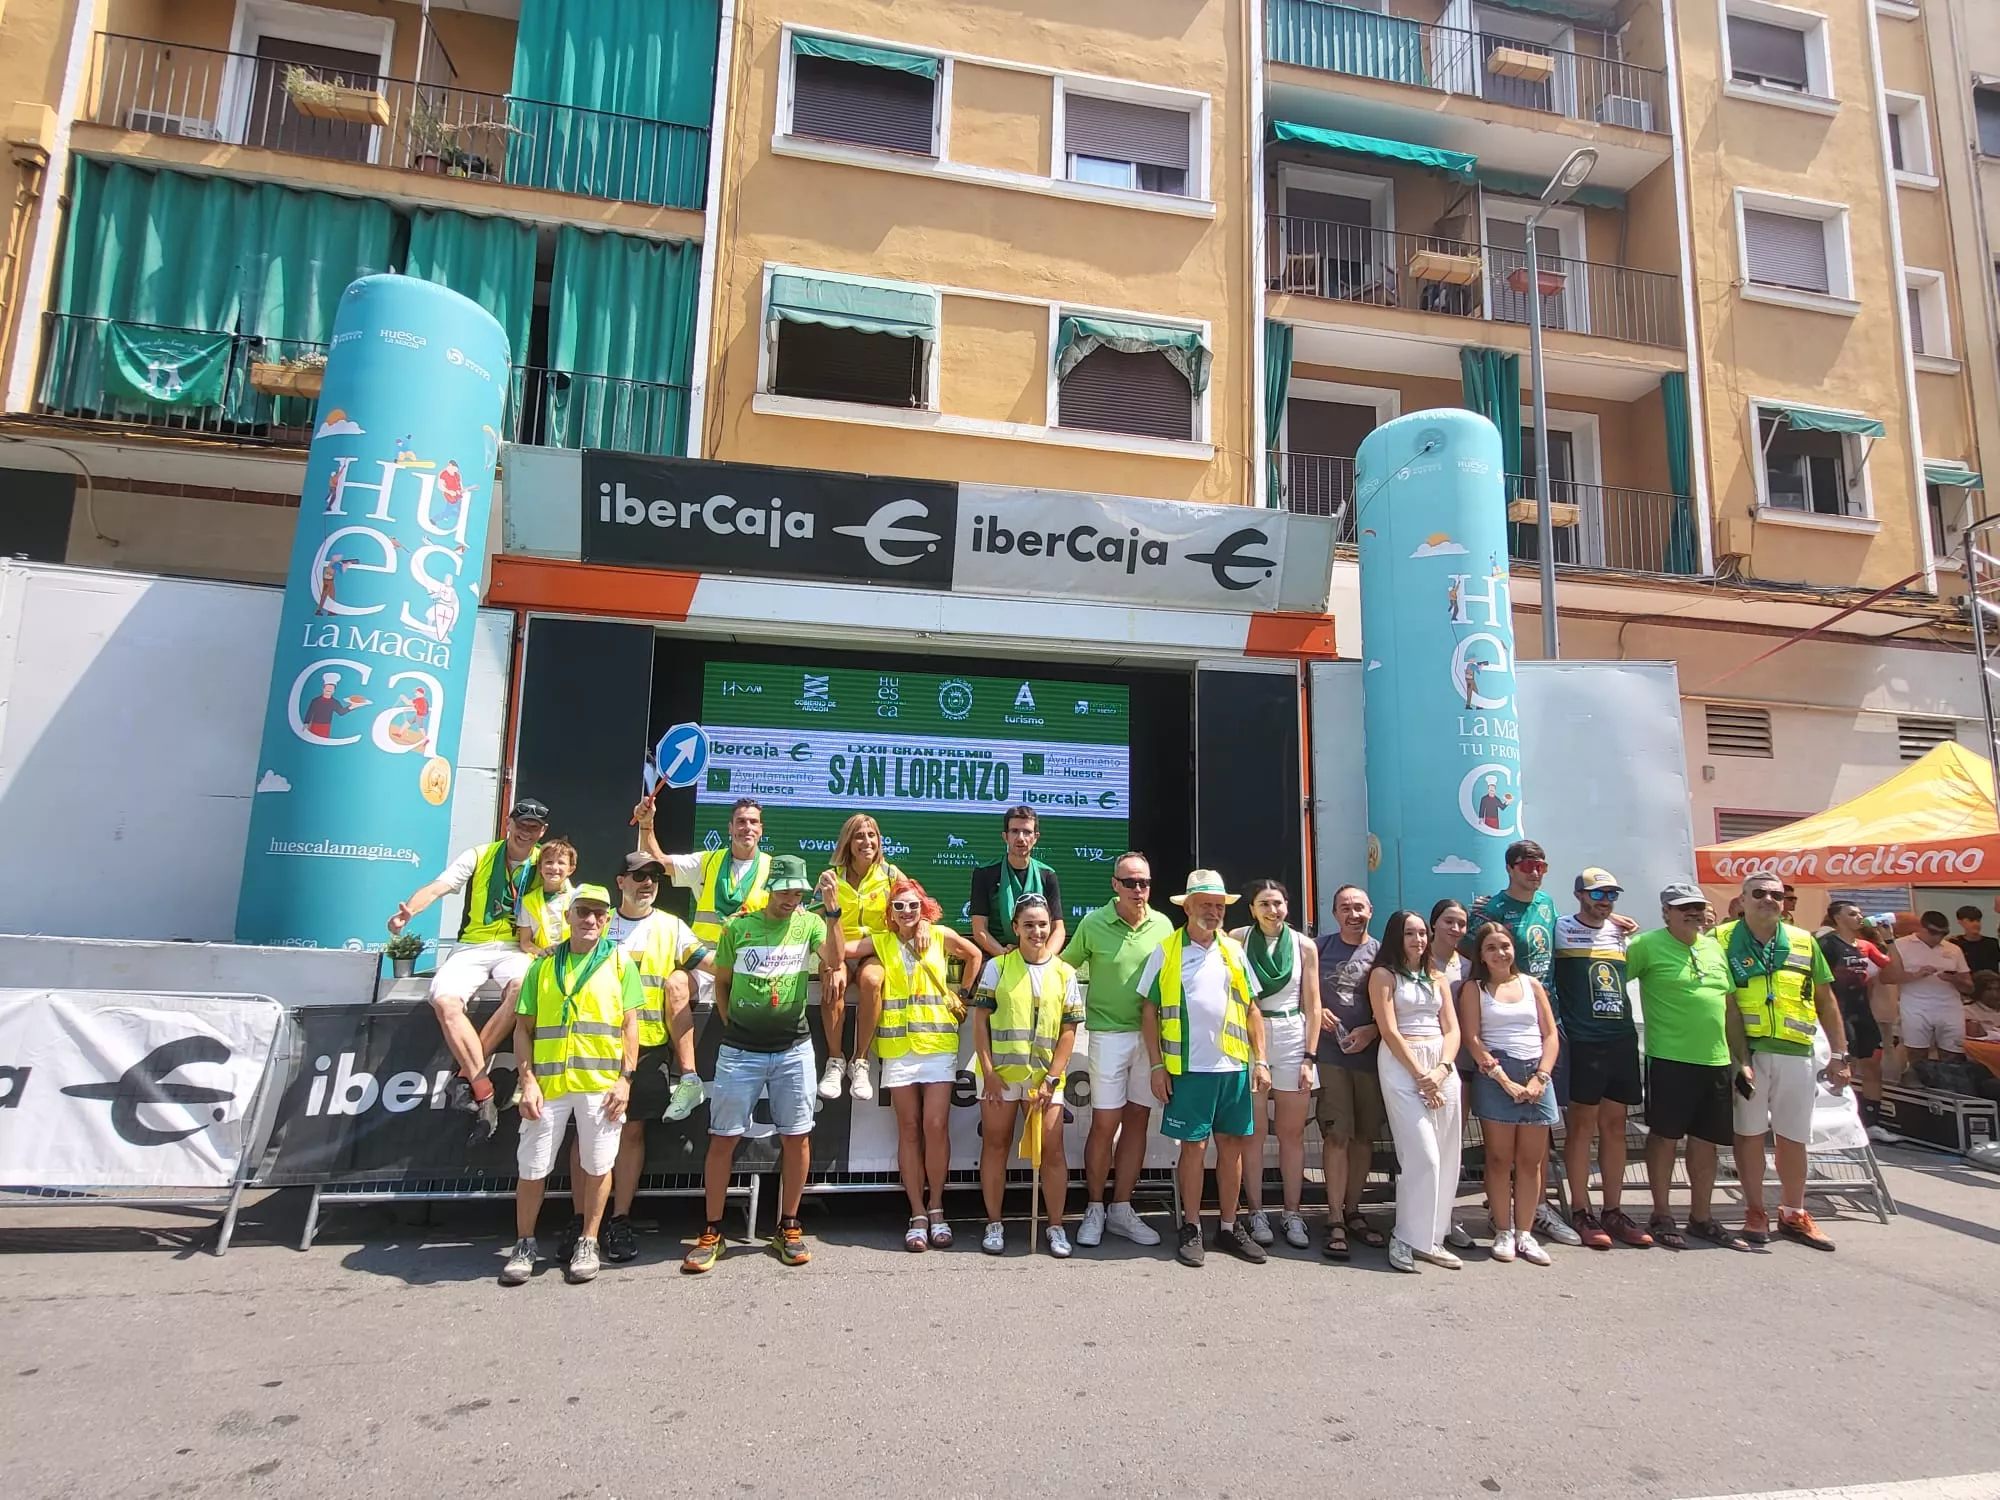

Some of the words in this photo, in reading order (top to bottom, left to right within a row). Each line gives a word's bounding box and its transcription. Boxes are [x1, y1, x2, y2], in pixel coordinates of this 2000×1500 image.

[599, 482, 815, 548] iberCaja
[972, 515, 1169, 574] iberCaja
[302, 623, 340, 648] La
[1005, 715, 1044, 725] turismo
[1457, 716, 1490, 737] La
[709, 741, 779, 759] Ibercaja
[848, 744, 887, 755] LXXII
[892, 746, 934, 757] GRAN
[938, 749, 993, 759] PREMIO
[1048, 753, 1121, 769] Ayuntamiento
[735, 768, 814, 783] Ayuntamiento
[828, 754, 886, 797] SAN
[895, 756, 1010, 801] LORENZO
[1063, 768, 1103, 779] Huesca
[751, 783, 794, 795] Huesca
[1022, 790, 1089, 808] Ibercaja
[270, 837, 413, 861] huescalamagia.es
[1824, 844, 1985, 875] ciclismo
